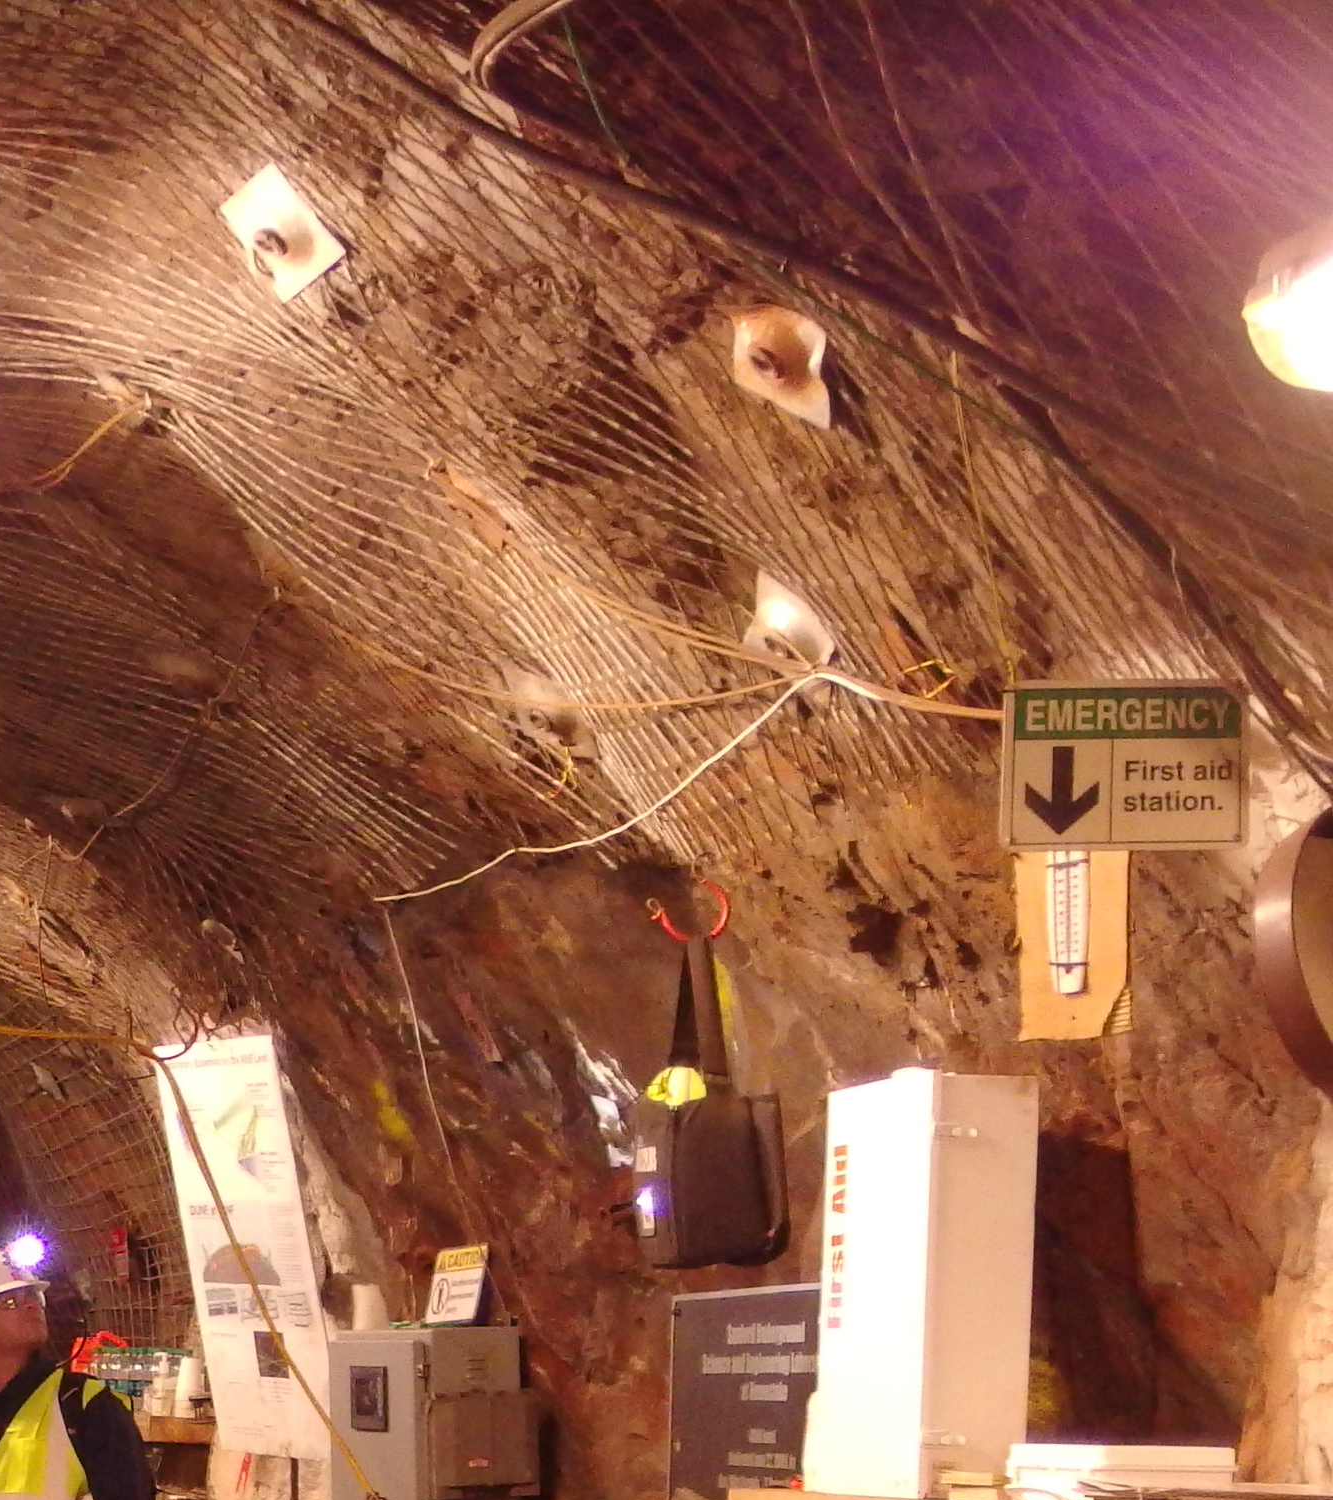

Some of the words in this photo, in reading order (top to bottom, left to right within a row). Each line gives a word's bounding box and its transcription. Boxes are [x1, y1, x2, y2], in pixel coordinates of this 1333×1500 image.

[1025, 699, 1229, 731] EMERGENCY
[1124, 759, 1184, 782] First
[1193, 758, 1233, 781] aid
[1123, 789, 1223, 812] station.
